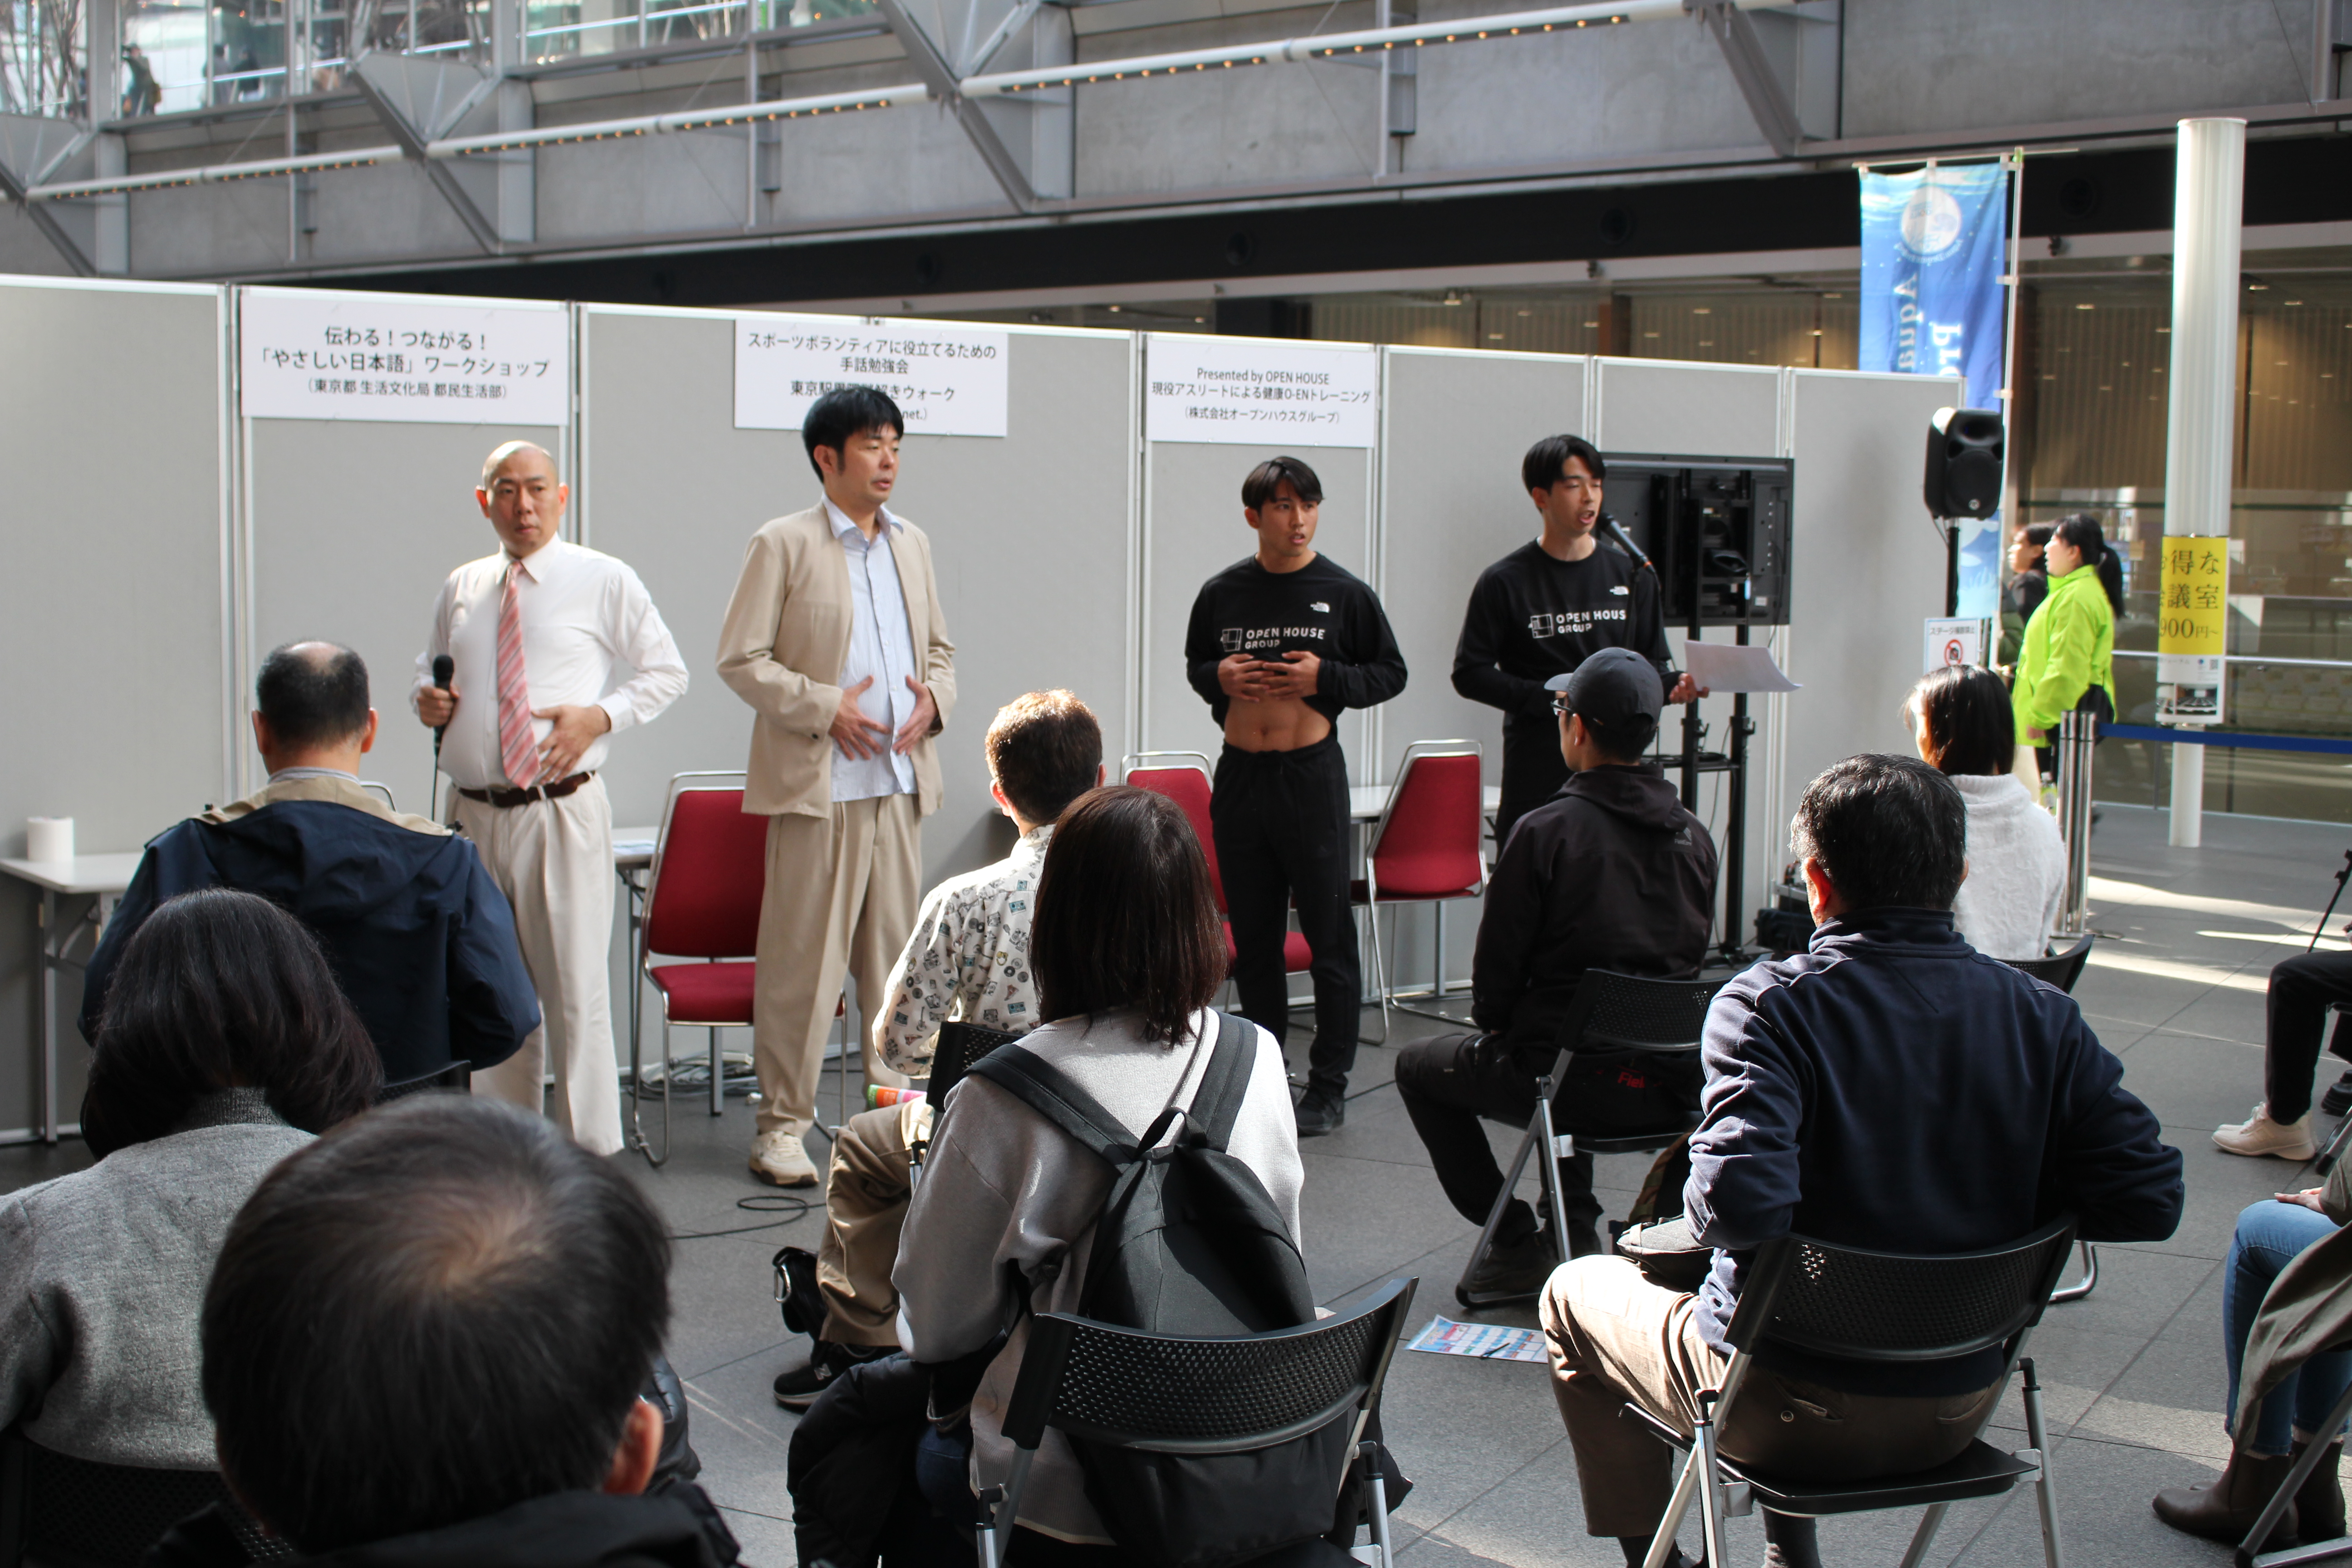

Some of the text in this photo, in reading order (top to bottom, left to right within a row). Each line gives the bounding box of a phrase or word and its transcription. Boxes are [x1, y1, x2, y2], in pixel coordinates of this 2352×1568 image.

[325, 326, 485, 350] 伝わる！つながる！
[749, 333, 996, 359] スポーツボランティアに役立てるための
[840, 357, 908, 374] 手話勉強会
[1197, 368, 1329, 385] Presented by OPEN HOUSE
[2159, 583, 2220, 610] 議室
[1556, 609, 1626, 624] OPEN HOUS
[1246, 627, 1325, 640] OPEN HOUSE
[1557, 622, 1592, 634] GROUP
[1245, 639, 1280, 650] GROUP
